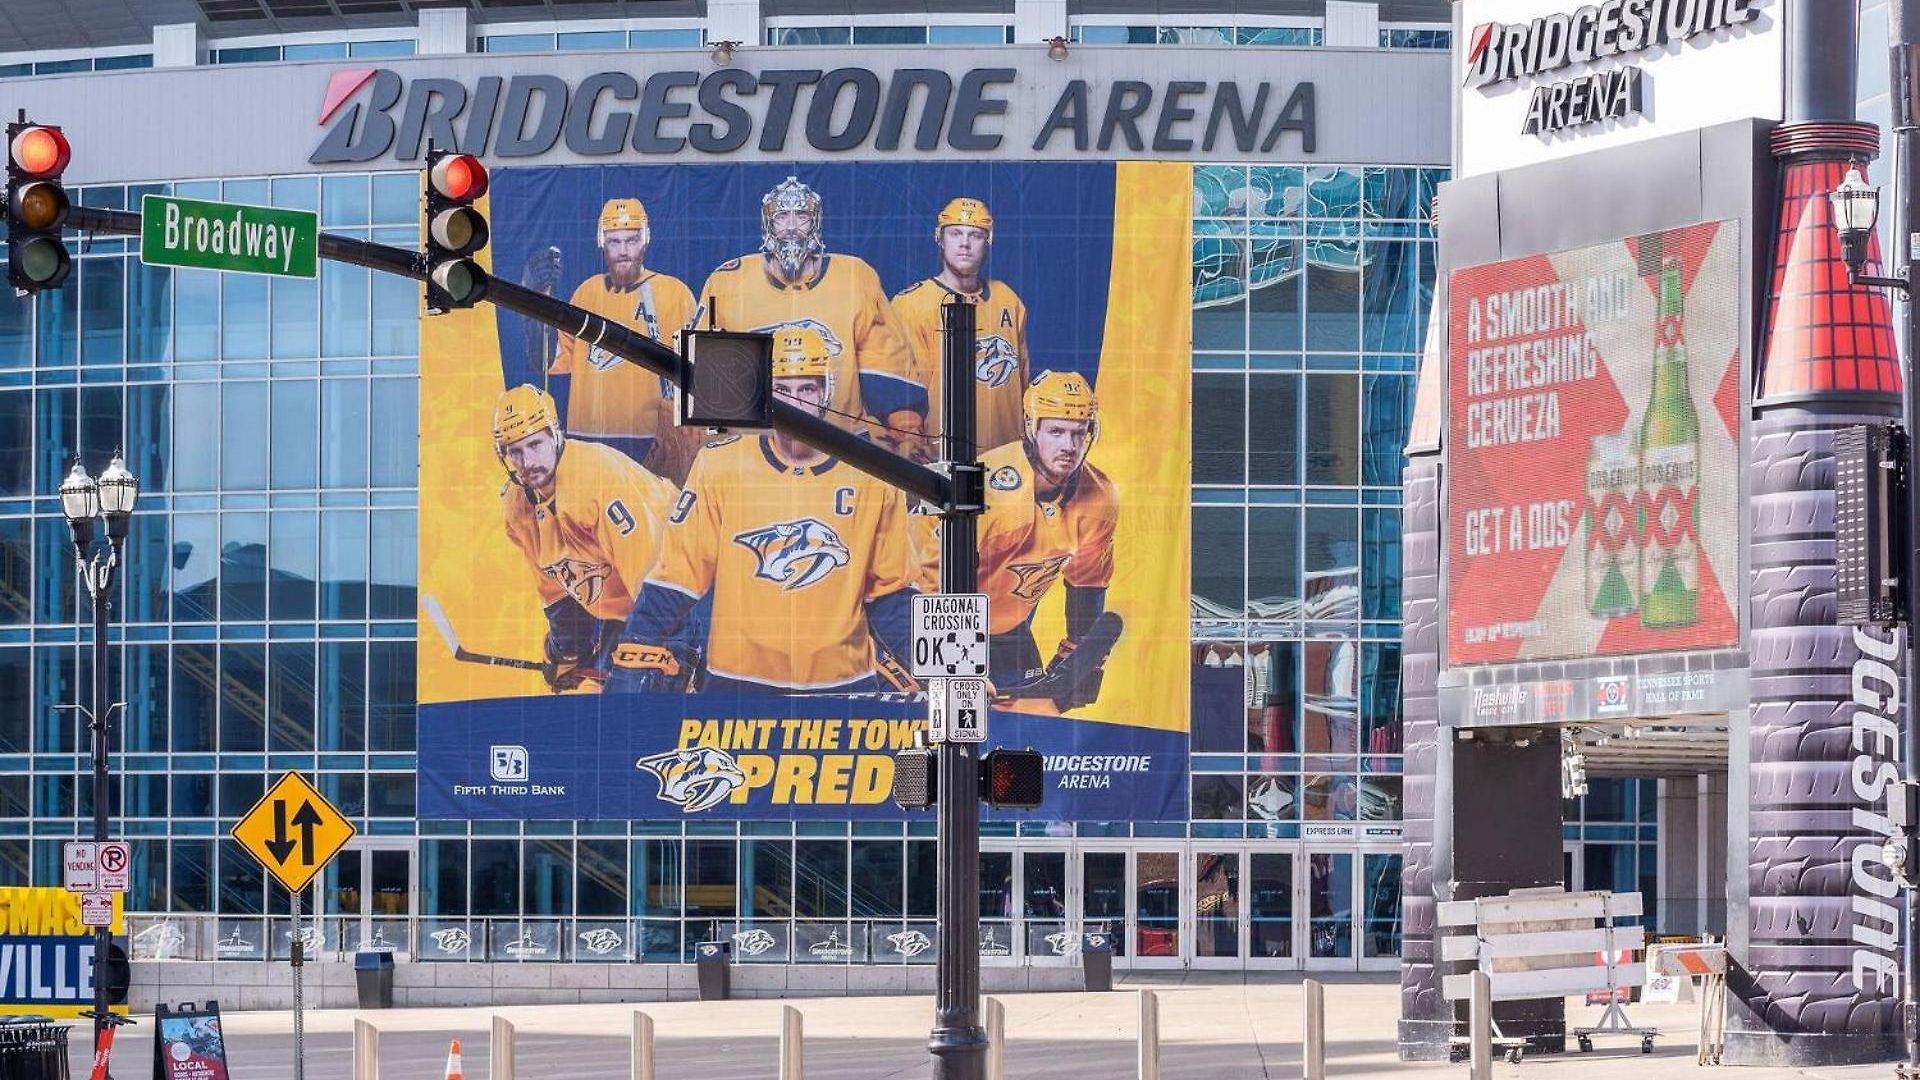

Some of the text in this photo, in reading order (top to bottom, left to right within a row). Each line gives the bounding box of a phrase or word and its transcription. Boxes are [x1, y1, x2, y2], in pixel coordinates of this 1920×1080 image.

[1522, 66, 1641, 134] ARENA
[309, 68, 1317, 163] BRIDGESTONE ARENA
[164, 203, 296, 272] Broadway
[1000, 308, 1013, 328] A
[1467, 297, 1481, 344] A
[1486, 280, 1581, 342] SMOOTH
[1467, 330, 1598, 396] REFRESHING
[1466, 392, 1560, 449] CERVEZA
[835, 487, 855, 515] C
[606, 499, 636, 536] 9
[1465, 507, 1502, 555] GET
[1509, 504, 1523, 551] A
[923, 599, 980, 614] DIAGONAL
[923, 615, 980, 631] CROSSING
[619, 651, 672, 665] CCM
[916, 637, 945, 666] OK
[954, 682, 981, 691] CROSS
[956, 690, 978, 699] ONLY
[961, 699, 974, 708] ON
[678, 719, 934, 751] PAINT THE TOW
[954, 730, 980, 738] SIGNAL
[454, 785, 566, 795] FIFTH THIRD BANK
[1058, 775, 1111, 789] ARENA
[1306, 827, 1336, 835] EXPRESS
[76, 849, 87, 858] NO
[173, 1061, 208, 1071] LOCAL
